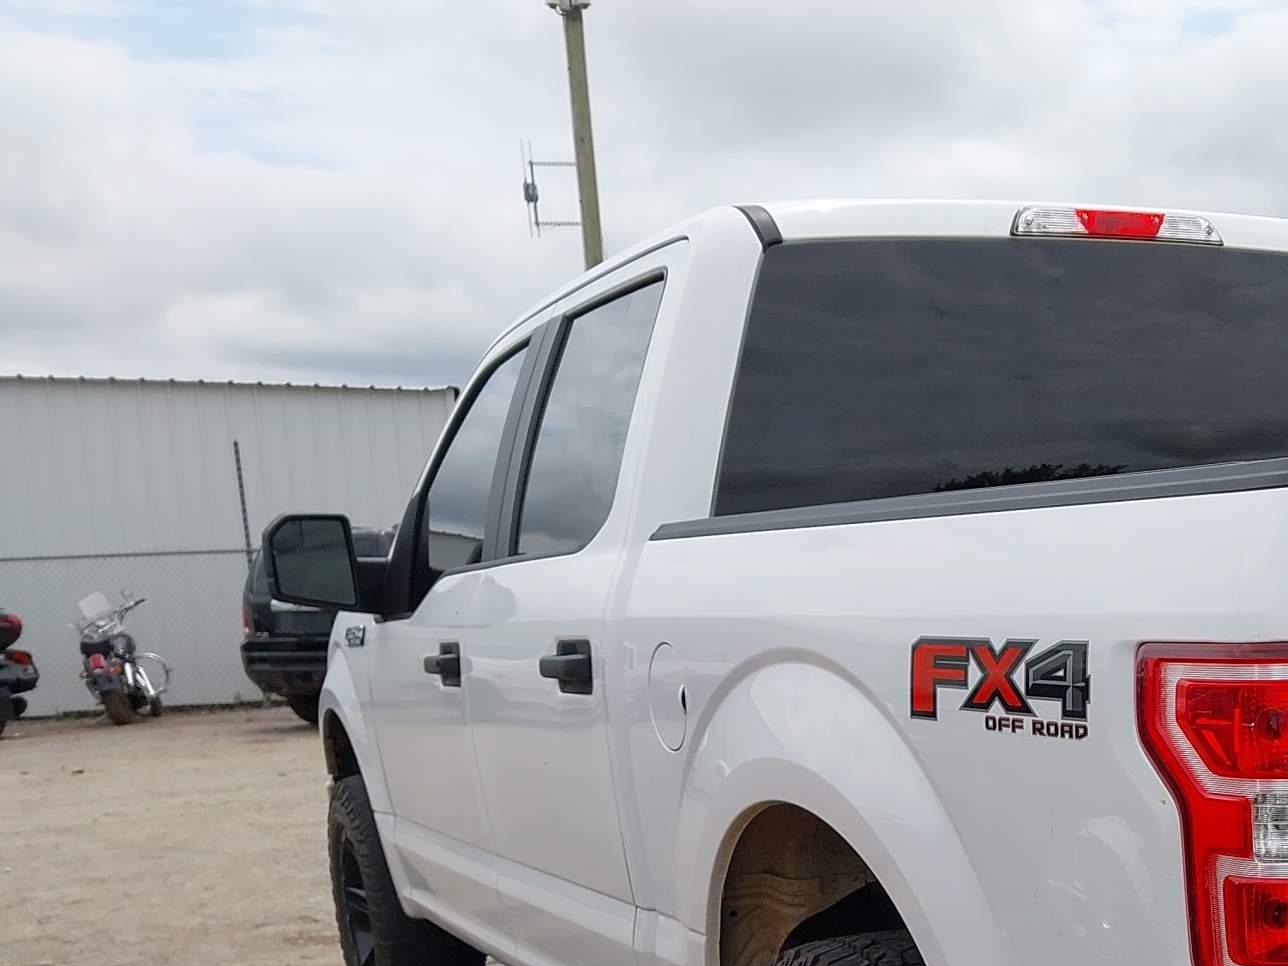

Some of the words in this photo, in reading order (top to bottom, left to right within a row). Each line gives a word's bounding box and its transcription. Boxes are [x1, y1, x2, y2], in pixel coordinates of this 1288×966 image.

[910, 635, 1091, 721] FX4
[985, 715, 1024, 733] OFF
[1032, 720, 1088, 740] ROAD
